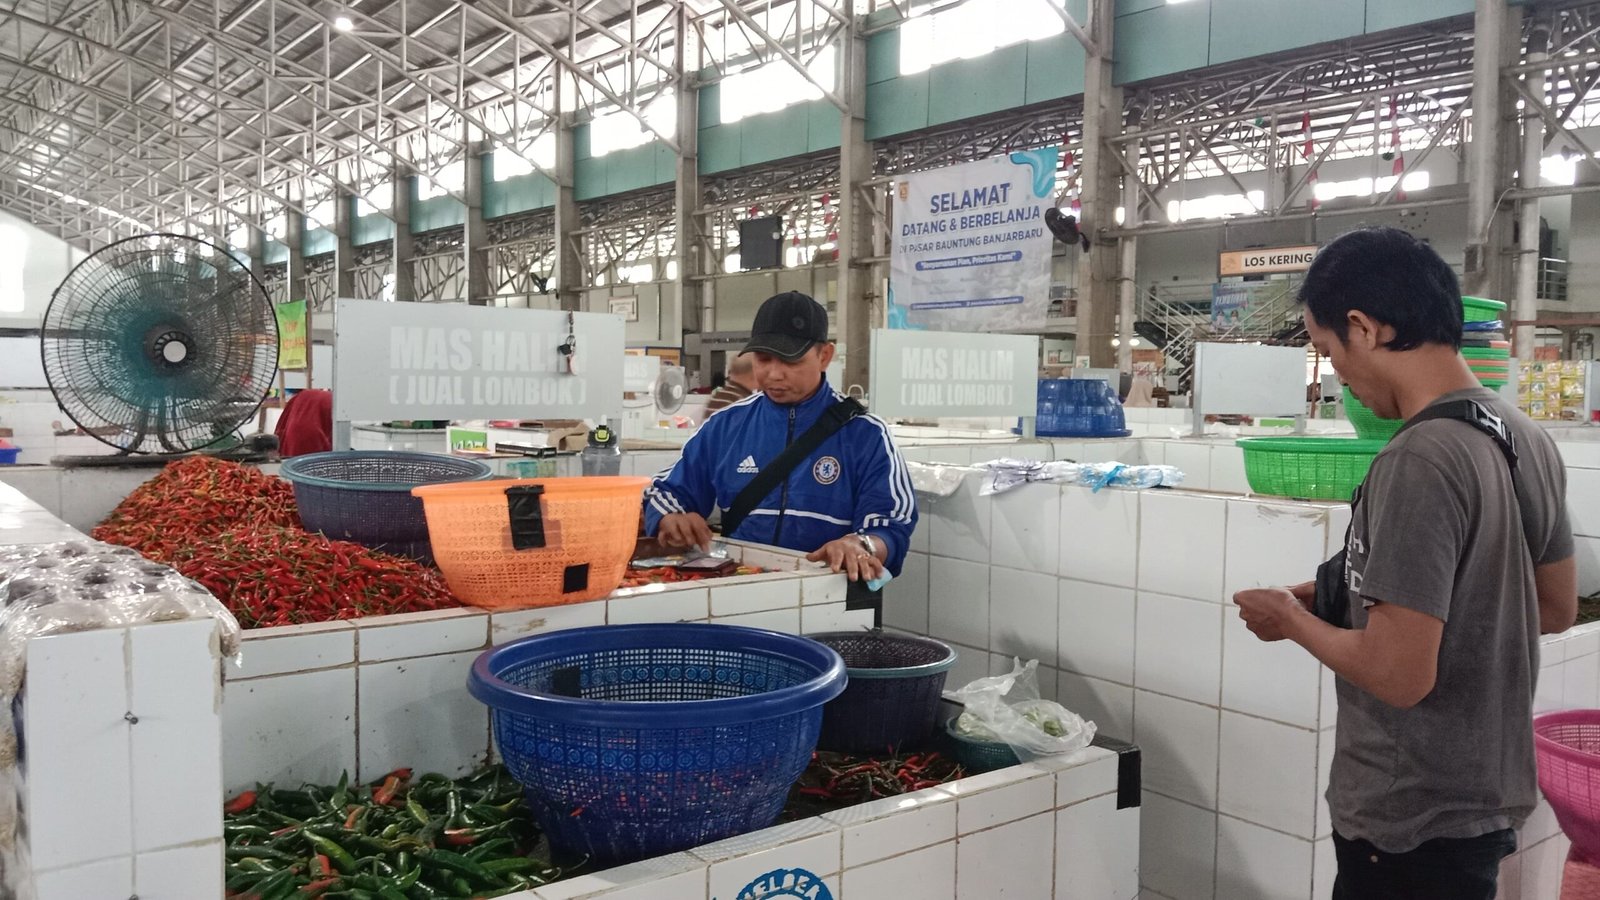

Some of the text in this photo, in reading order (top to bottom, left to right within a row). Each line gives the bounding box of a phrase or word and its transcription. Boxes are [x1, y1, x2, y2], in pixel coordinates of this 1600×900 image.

[931, 183, 1011, 214] SELAMAT
[902, 205, 1040, 237] DATANG & BERBELANJA
[909, 241, 934, 252] PASAR
[936, 236, 981, 250] BAUNTUNG
[983, 228, 1043, 245] BANJARBARU
[1245, 253, 1313, 267] LOS KERING
[390, 327, 472, 371] MAS
[901, 348, 1014, 381] MAS HALIM
